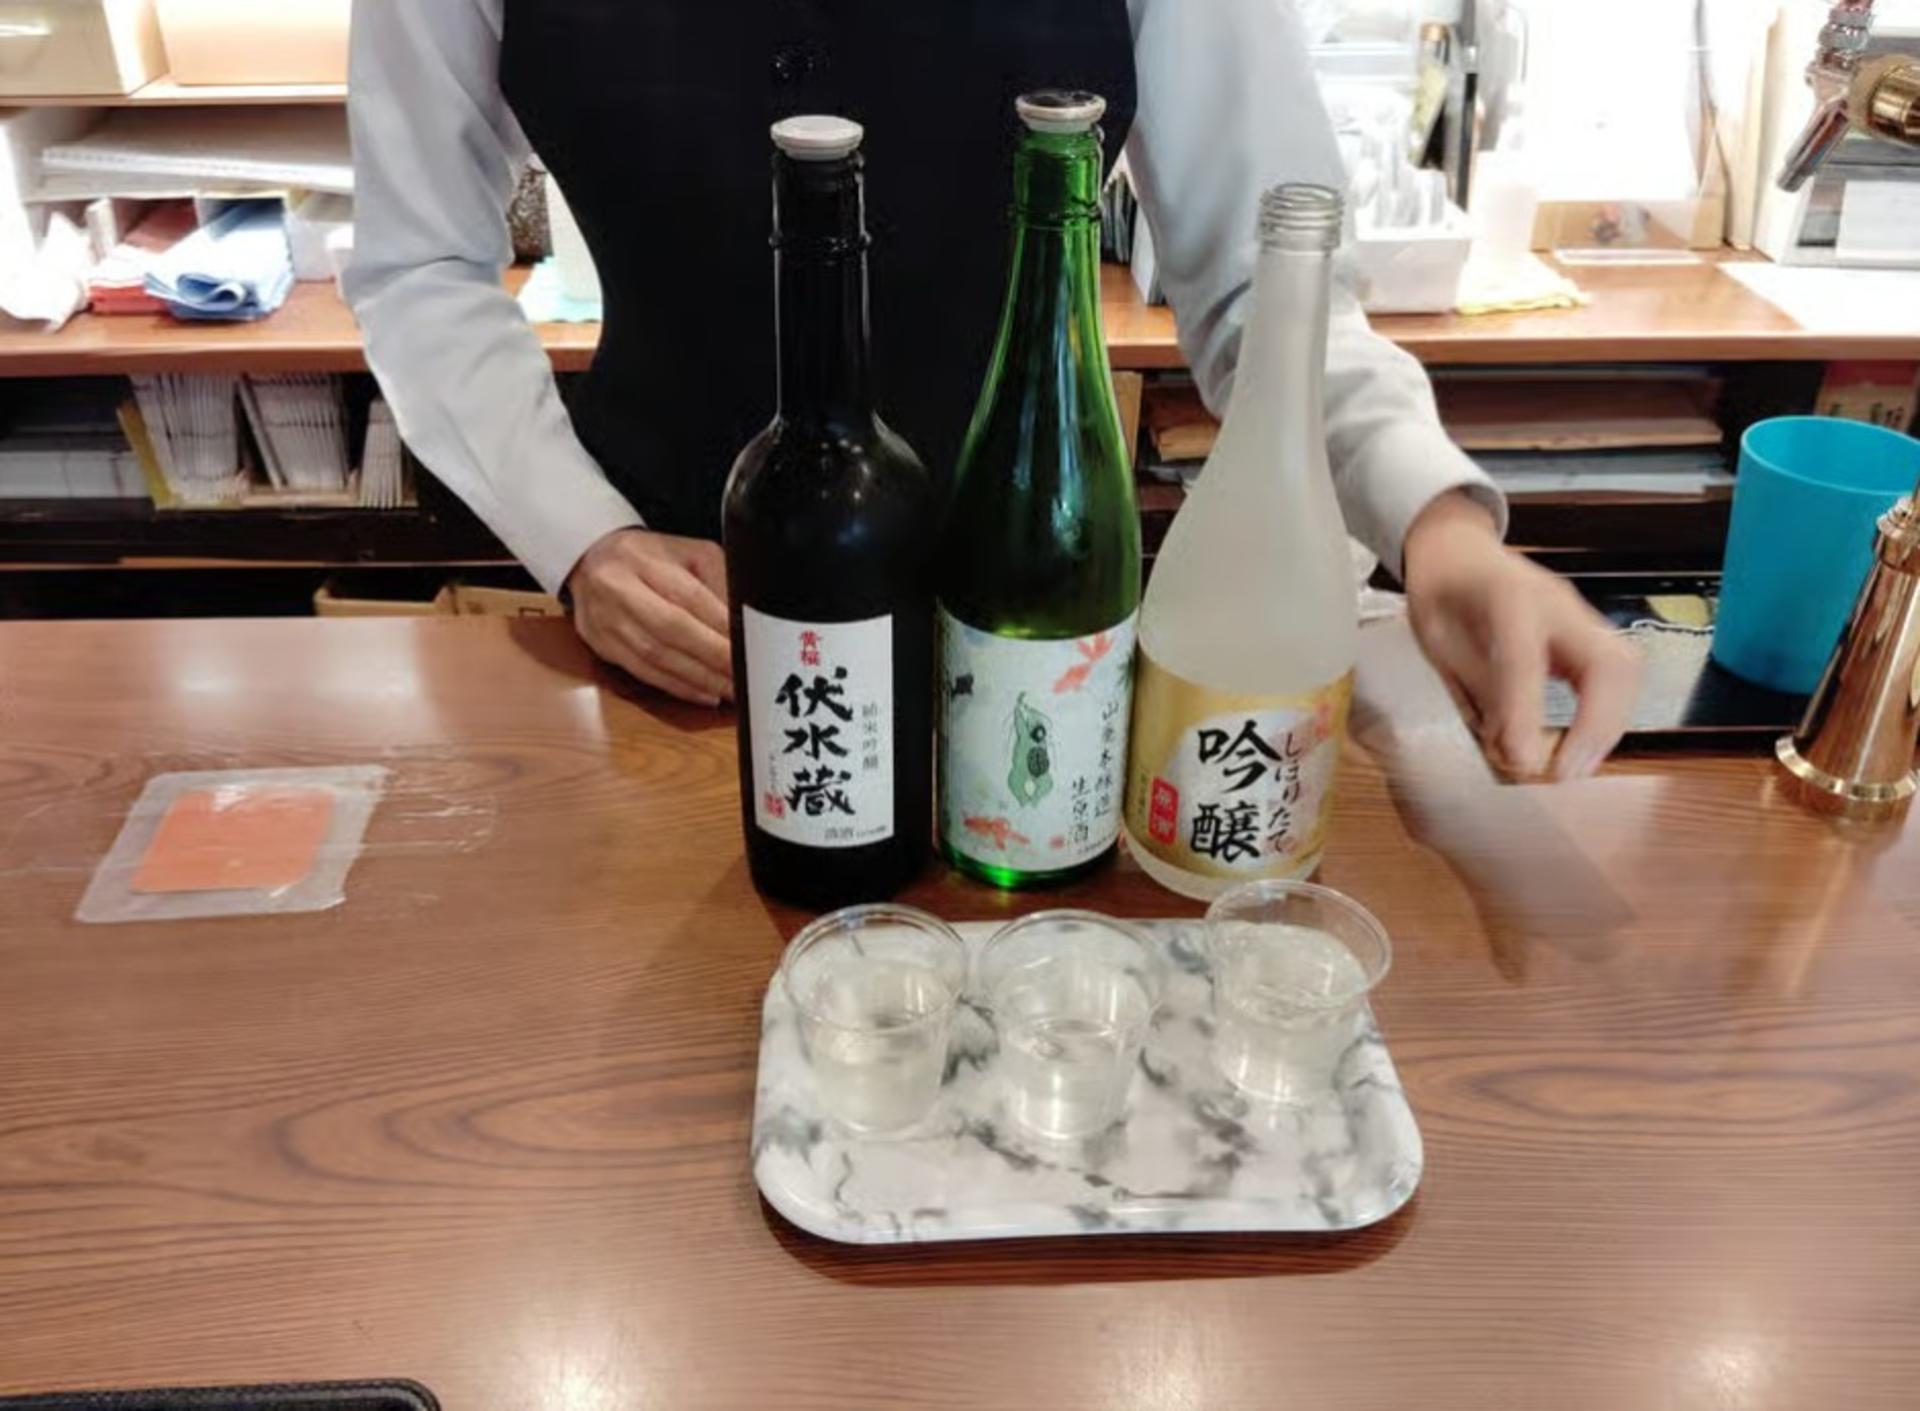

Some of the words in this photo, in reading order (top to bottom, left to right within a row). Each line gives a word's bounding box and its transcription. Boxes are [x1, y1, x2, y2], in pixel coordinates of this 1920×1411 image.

[776, 665, 856, 816] 伏水蔵
[1190, 719, 1283, 863] 吟醸
[1267, 732, 1302, 854] しぼりたて
